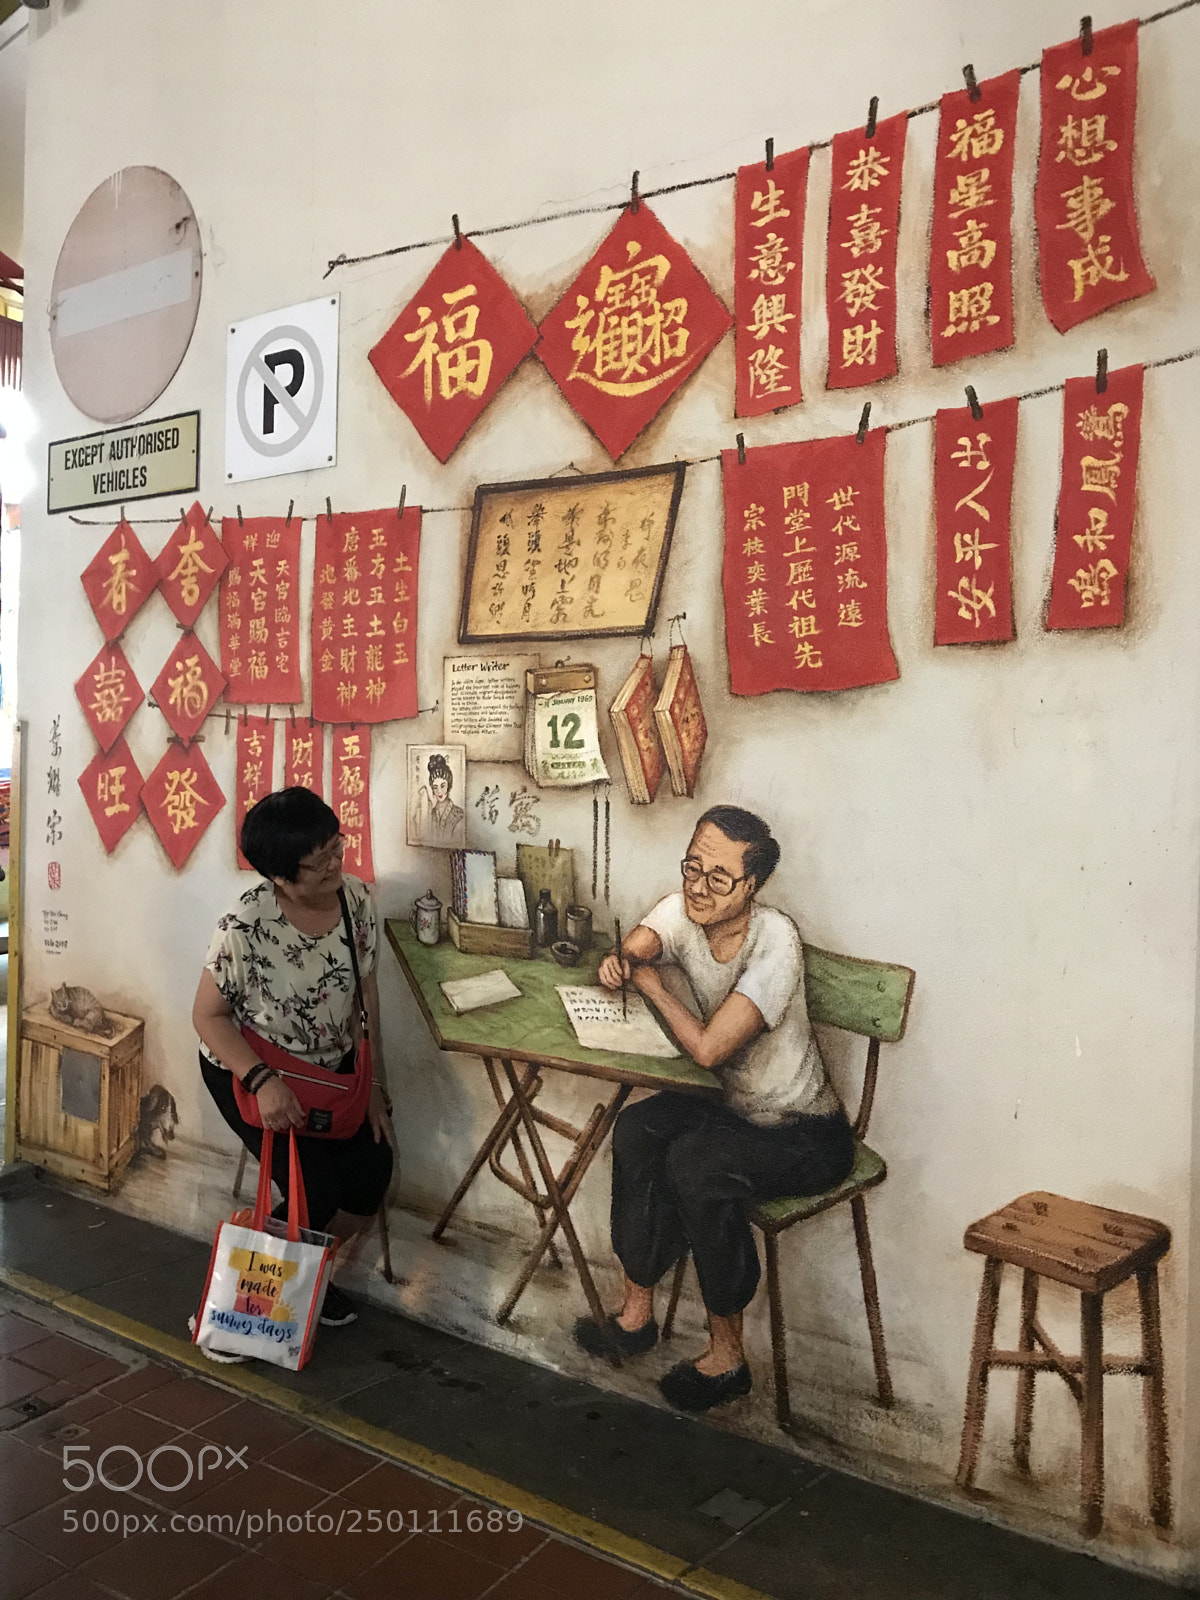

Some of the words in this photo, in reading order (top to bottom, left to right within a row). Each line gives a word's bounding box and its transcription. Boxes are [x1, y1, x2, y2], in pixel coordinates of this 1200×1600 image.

[941, 108, 1004, 338] 福星高照
[1055, 65, 1130, 303] 心想事成
[746, 179, 796, 399] 生意興隆
[834, 146, 891, 369] 恭喜發財
[397, 284, 494, 412] 福
[64, 442, 105, 471] EXCEPT
[109, 427, 180, 461] AUTHORISED
[92, 466, 147, 495] VEHICLES
[826, 485, 868, 628] 世代源流遠
[947, 432, 1001, 628] 出入平安
[247, 557, 269, 685] 天官賜福
[274, 559, 291, 674] 天官臨吉宅
[168, 654, 209, 718] 福
[452, 662, 478, 673] Letter
[480, 660, 510, 672] Writer
[546, 712, 585, 750] 12
[97, 766, 130, 818] 旺
[159, 767, 210, 834] 發
[339, 734, 367, 867] 五福臨門
[240, 1278, 280, 1298] made
[246, 1250, 259, 1272] I
[259, 1262, 283, 1277] was
[210, 1309, 257, 1336] sunny
[257, 1316, 293, 1344] days
